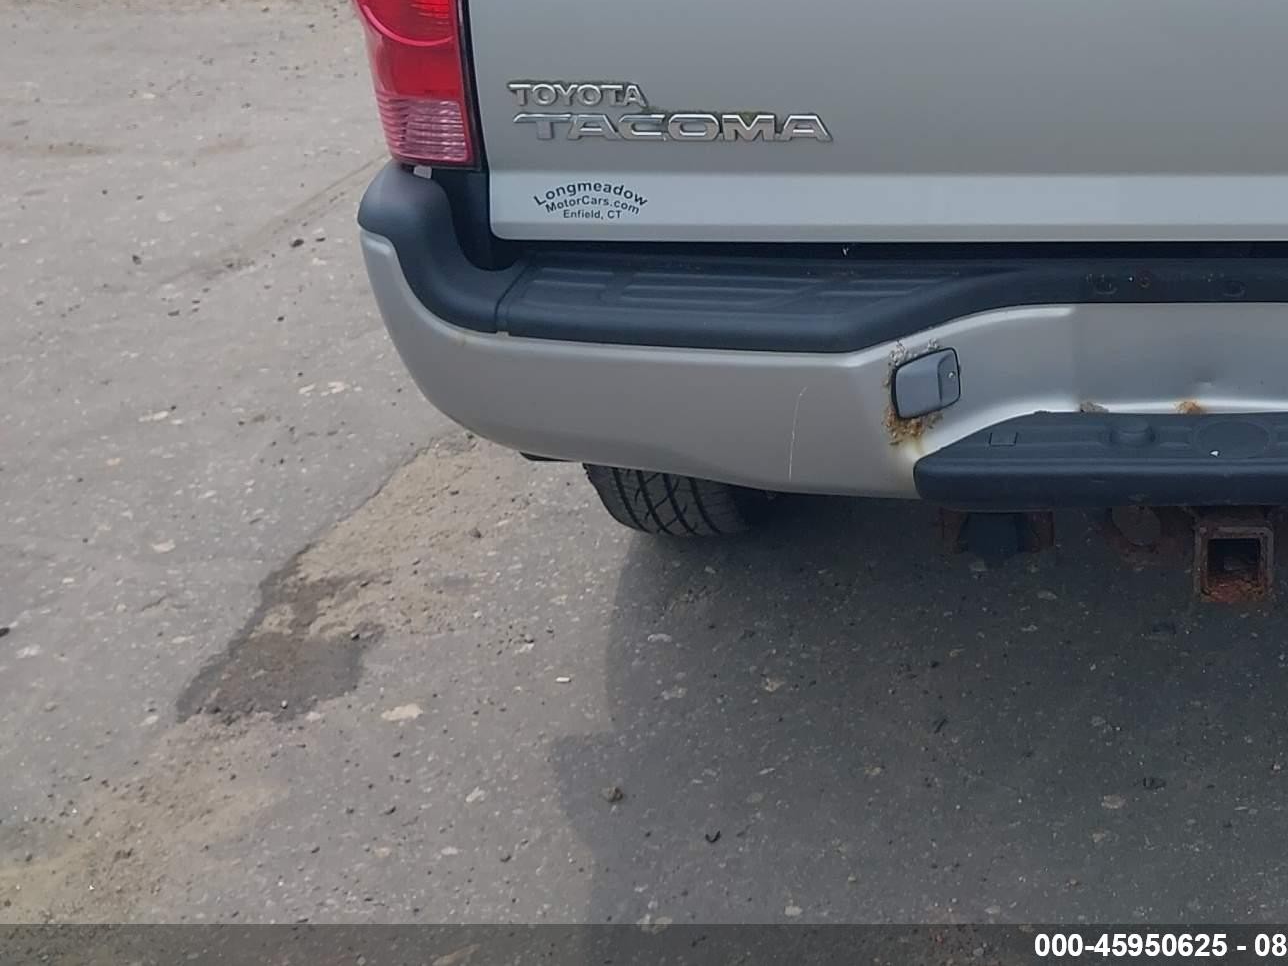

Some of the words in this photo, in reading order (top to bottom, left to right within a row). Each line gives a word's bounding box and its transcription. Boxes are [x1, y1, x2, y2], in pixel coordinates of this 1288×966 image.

[507, 82, 648, 107] TOYOTA
[513, 112, 835, 142] TACOMA
[533, 181, 648, 206] Longmeadow
[545, 195, 640, 215] MotorCars.com
[563, 209, 604, 220] Enfield,
[607, 209, 622, 219] CT
